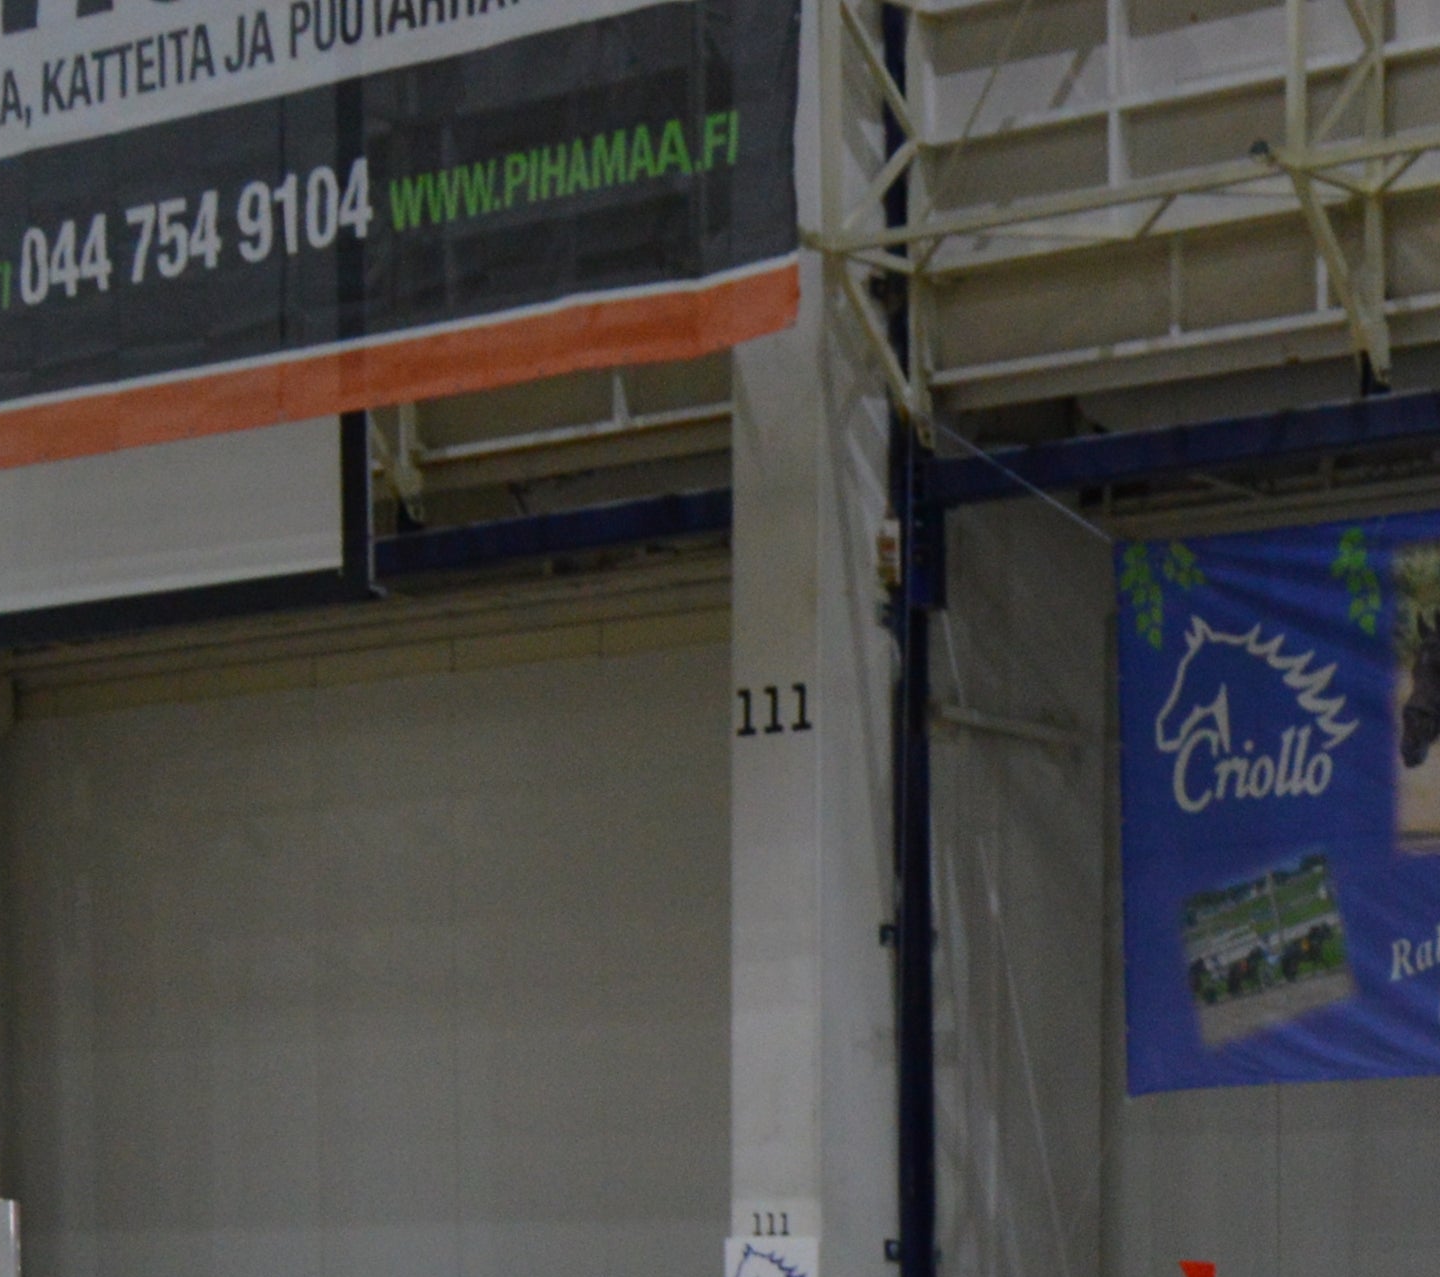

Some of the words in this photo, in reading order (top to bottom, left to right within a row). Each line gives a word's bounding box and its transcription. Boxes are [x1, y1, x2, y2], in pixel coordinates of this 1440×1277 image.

[42, 24, 216, 115] KATTEITA
[224, 10, 274, 73] JA
[20, 213, 112, 304] 044
[126, 190, 222, 284] 754
[237, 157, 373, 263] 9104
[389, 110, 740, 231] WWW.PIHAMAA.FI
[736, 683, 812, 736] 111
[1173, 725, 1333, 813] Criollo
[753, 1213, 789, 1236] 111
